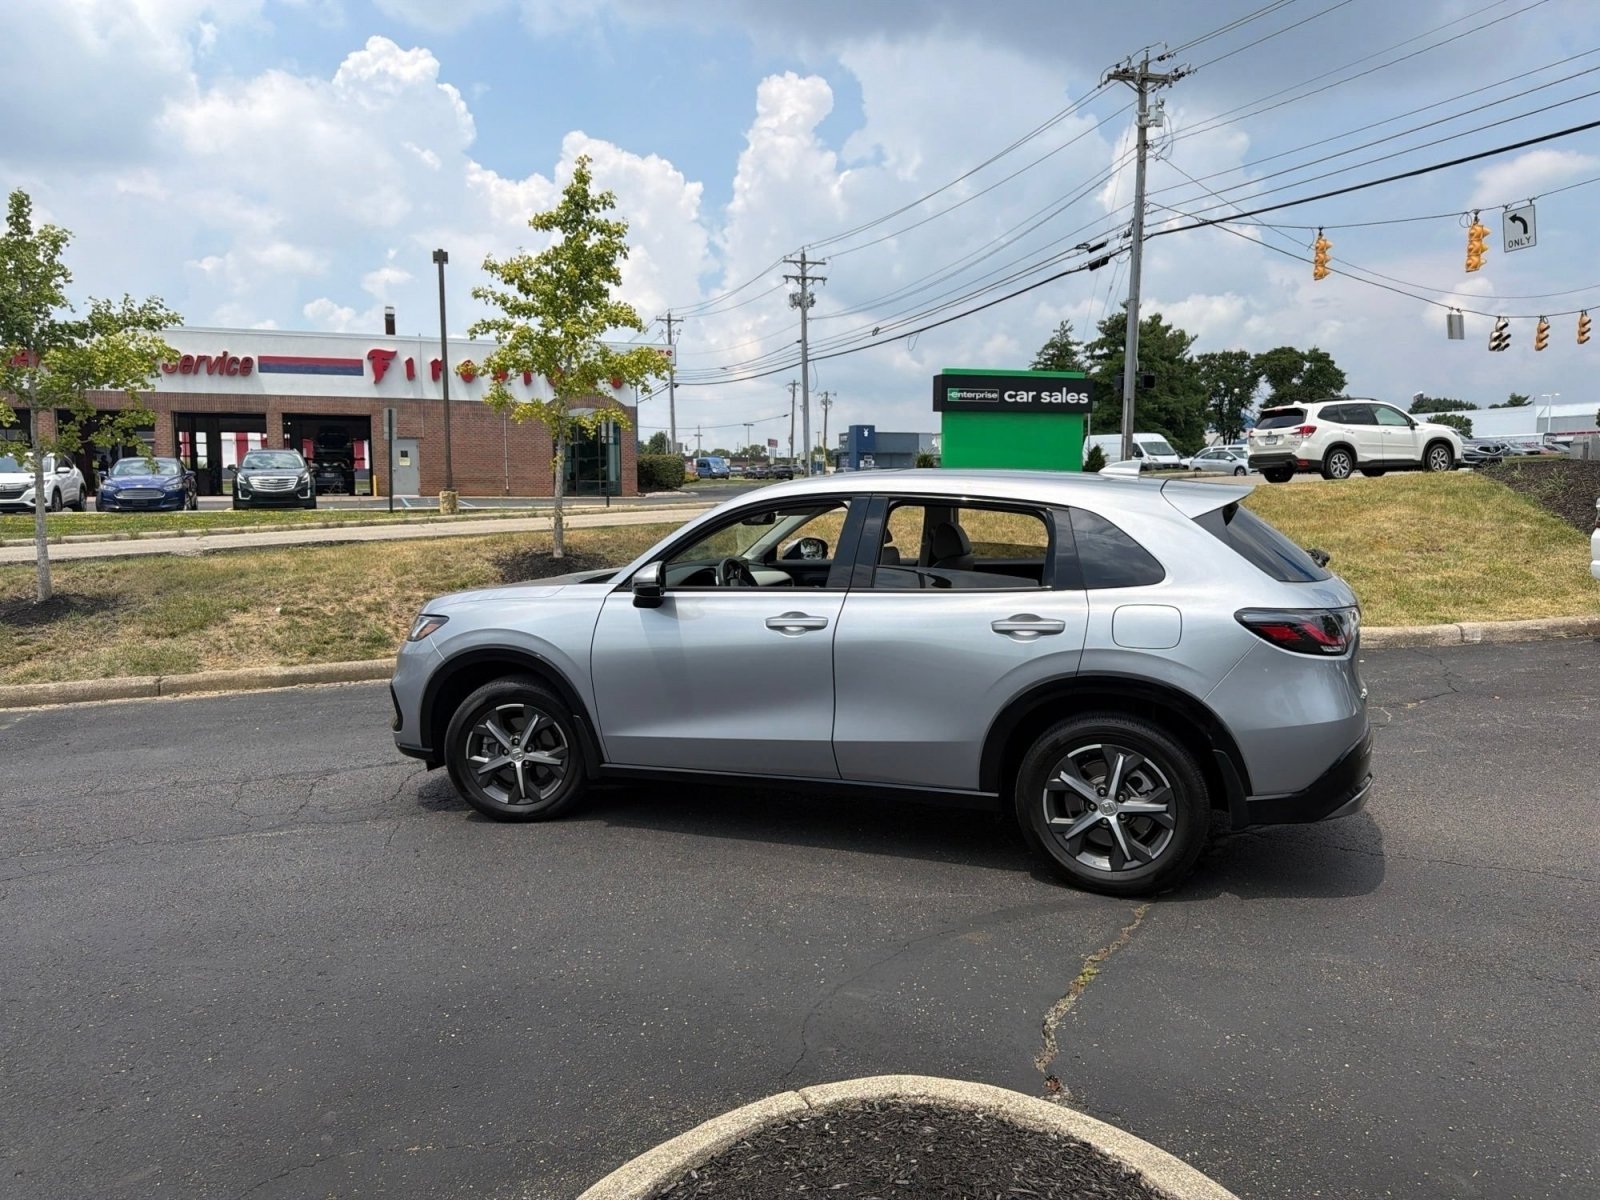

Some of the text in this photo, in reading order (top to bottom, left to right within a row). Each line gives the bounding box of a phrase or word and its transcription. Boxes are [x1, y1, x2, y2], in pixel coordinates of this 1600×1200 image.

[1508, 236, 1531, 248] ONLY
[162, 349, 254, 376] Service
[367, 349, 623, 389] Firet
[950, 387, 1089, 404] enterprise car sales
